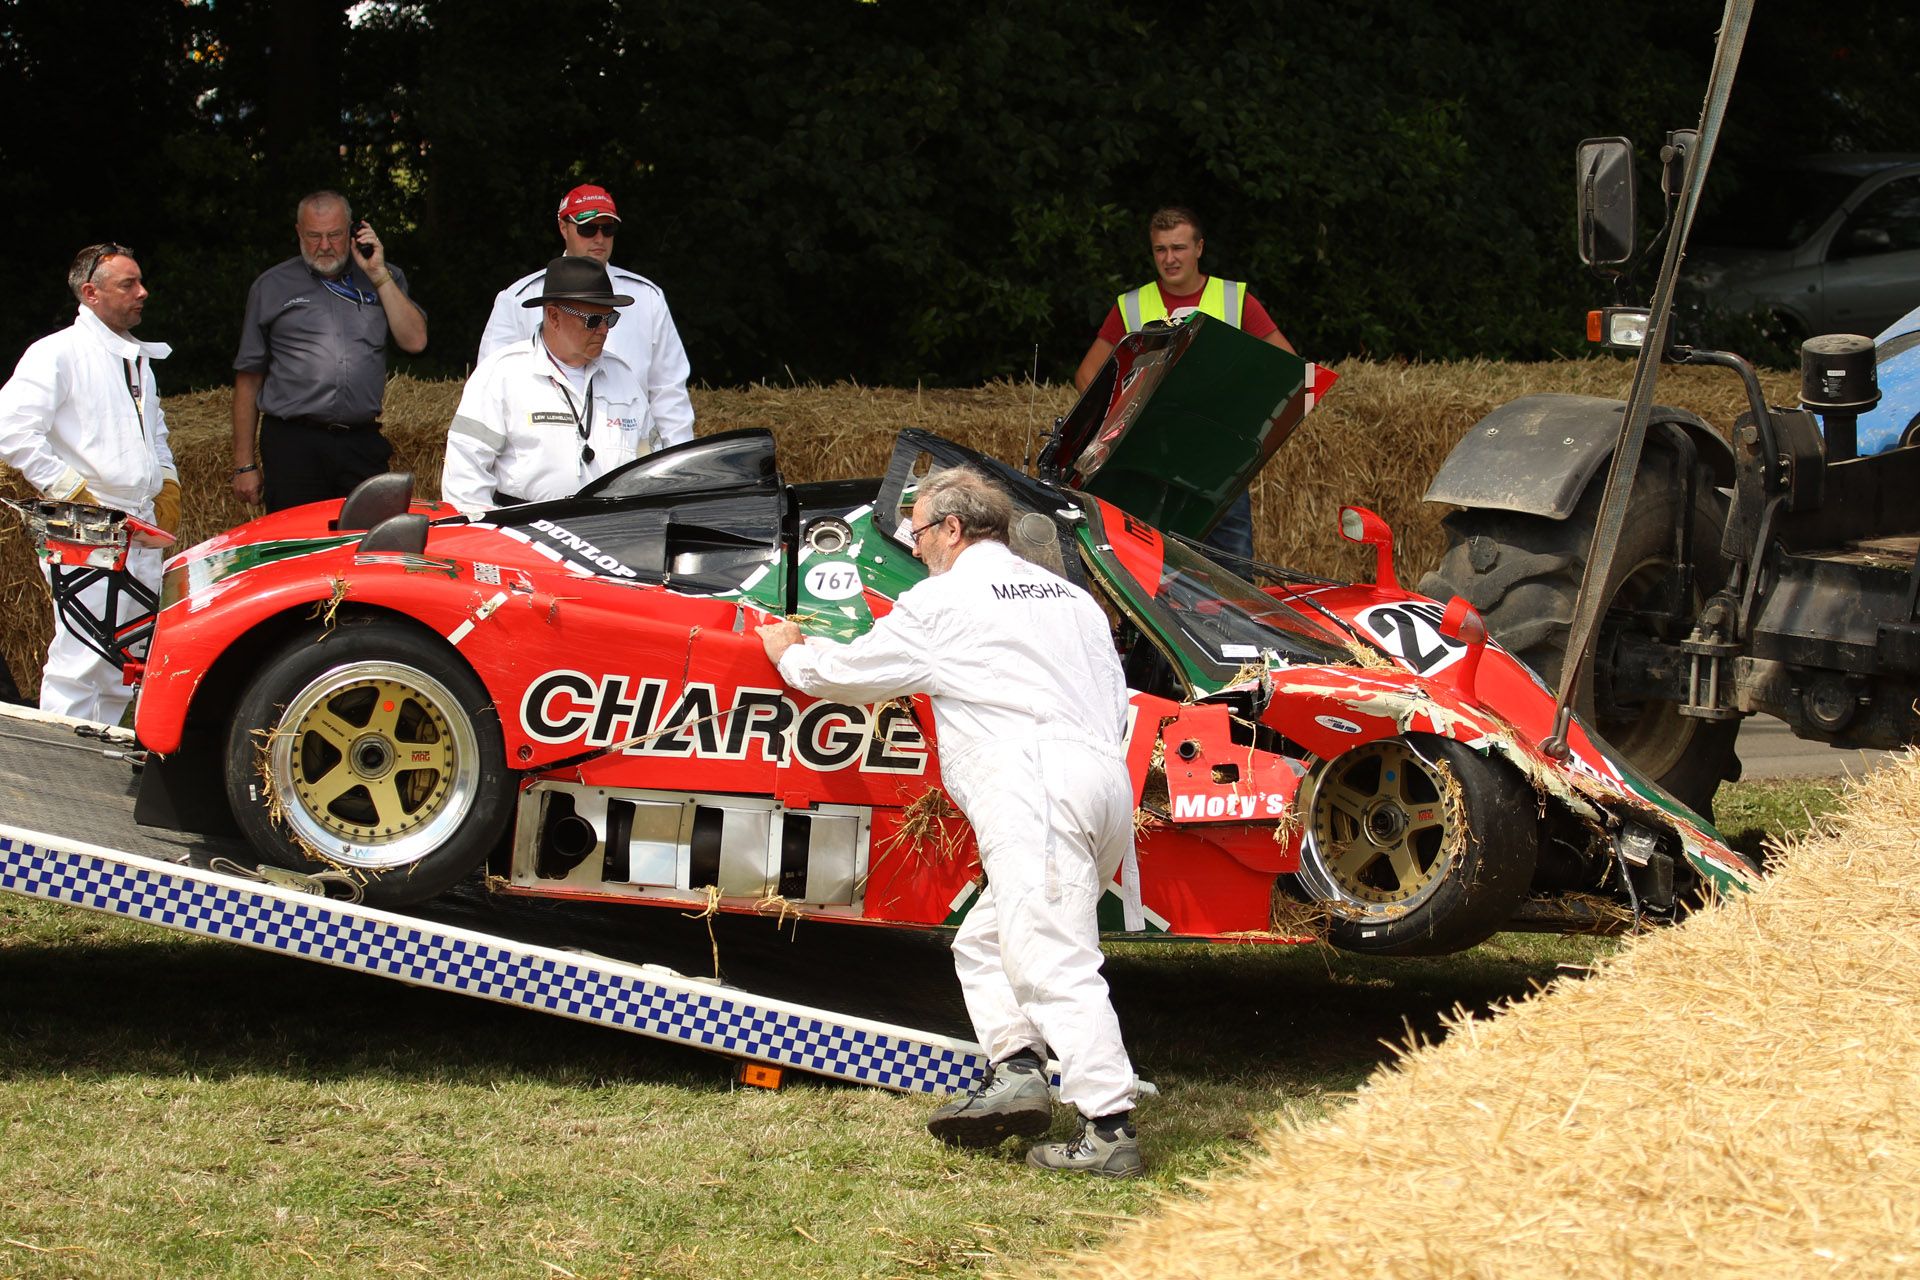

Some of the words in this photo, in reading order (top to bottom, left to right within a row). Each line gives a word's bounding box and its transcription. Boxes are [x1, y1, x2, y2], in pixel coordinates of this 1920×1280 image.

[607, 418, 622, 427] 24
[528, 519, 637, 577] DUNLOP
[815, 571, 855, 590] 767
[991, 583, 1078, 600] MARSHAL
[519, 669, 929, 775] CHARGE
[1175, 792, 1284, 819] Moty's
